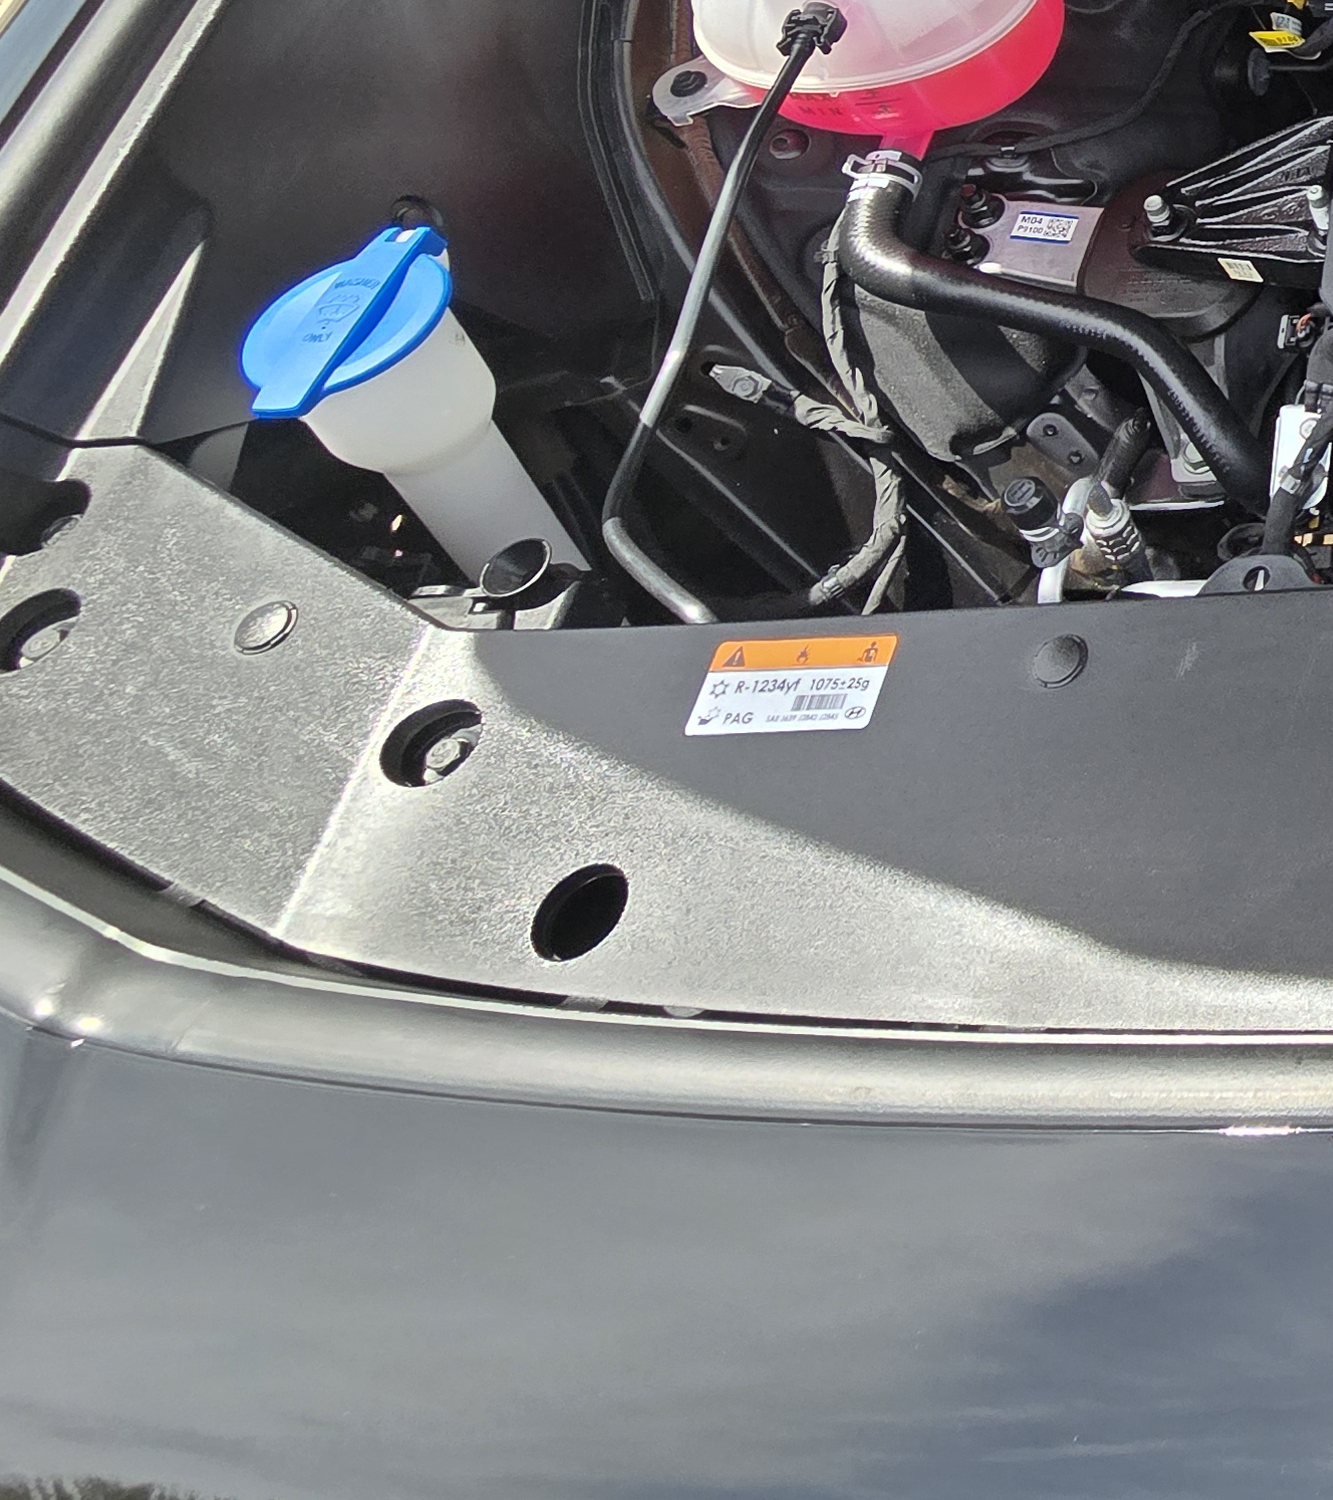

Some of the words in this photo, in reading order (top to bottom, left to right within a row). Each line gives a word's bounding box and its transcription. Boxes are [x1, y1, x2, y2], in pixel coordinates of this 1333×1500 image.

[1020, 215, 1044, 225] M04
[1016, 224, 1044, 234] P9100
[333, 277, 381, 291] WASHER
[301, 330, 334, 344] ONLY
[734, 677, 801, 696] R-1234yf
[809, 677, 870, 692] 1075±25g
[722, 711, 754, 726] PAG
